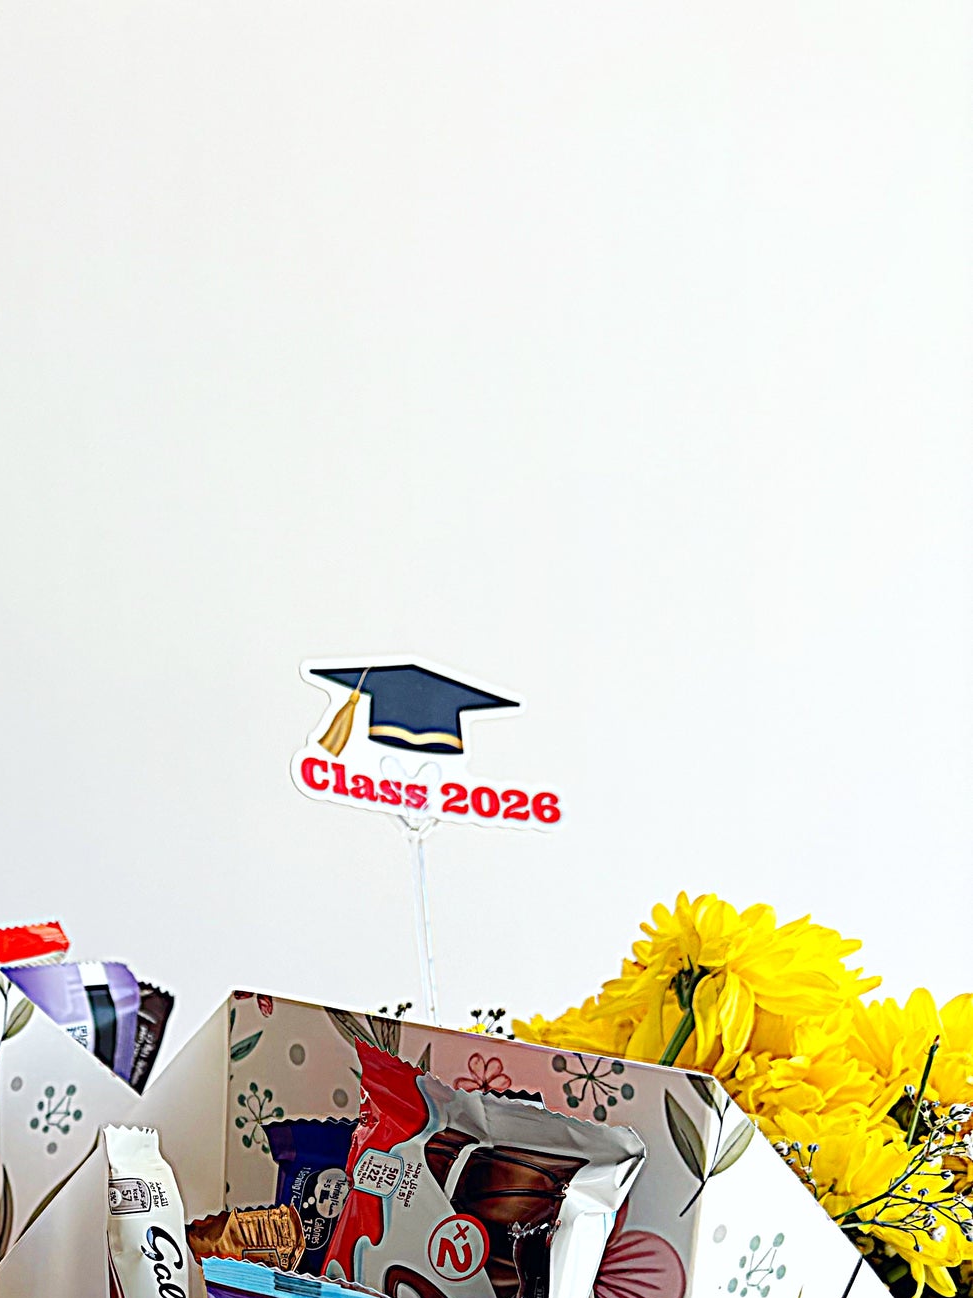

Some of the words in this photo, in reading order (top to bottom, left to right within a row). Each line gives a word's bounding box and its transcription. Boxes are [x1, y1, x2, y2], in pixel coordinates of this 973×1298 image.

[301, 757, 428, 810] Class
[440, 782, 561, 823] 2026
[367, 1164, 382, 1181] 122
[384, 1168, 398, 1186] 507
[122, 1190, 132, 1201] 57
[311, 1218, 325, 1244] Calories
